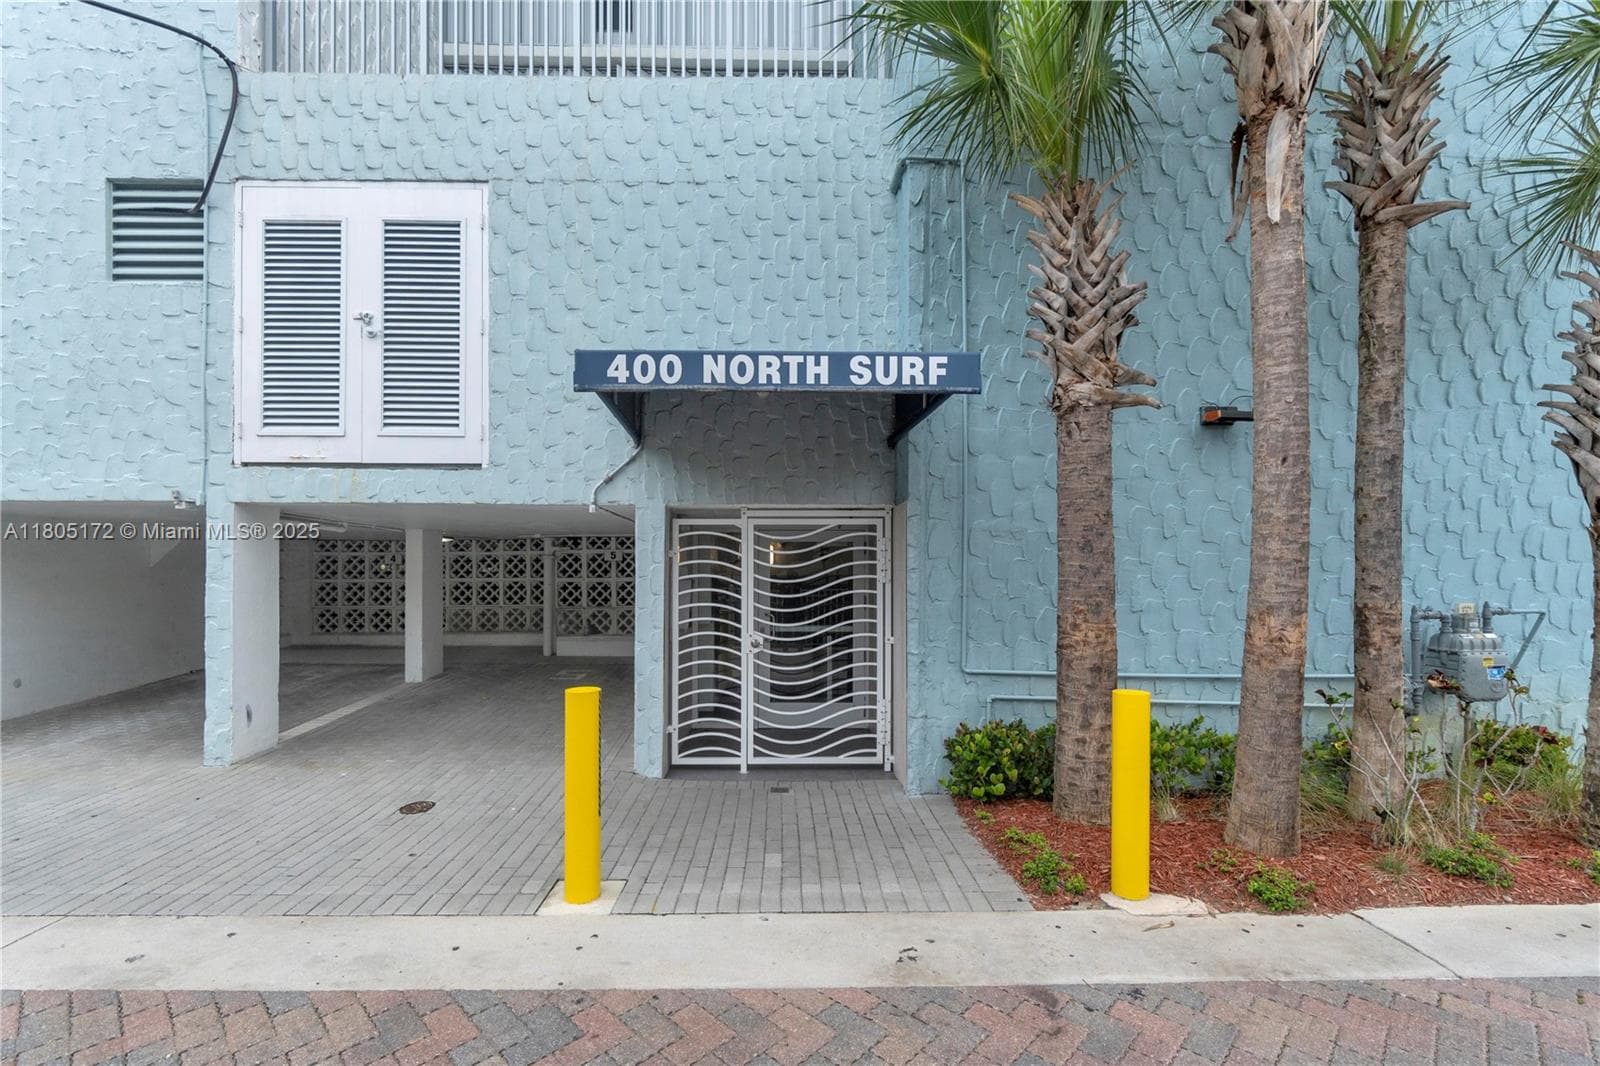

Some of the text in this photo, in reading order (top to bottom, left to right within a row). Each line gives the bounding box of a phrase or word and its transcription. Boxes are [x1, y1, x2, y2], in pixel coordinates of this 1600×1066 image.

[606, 353, 949, 386] 400 NORTH SURF
[390, 554, 396, 562] 4
[610, 551, 616, 560] 5
